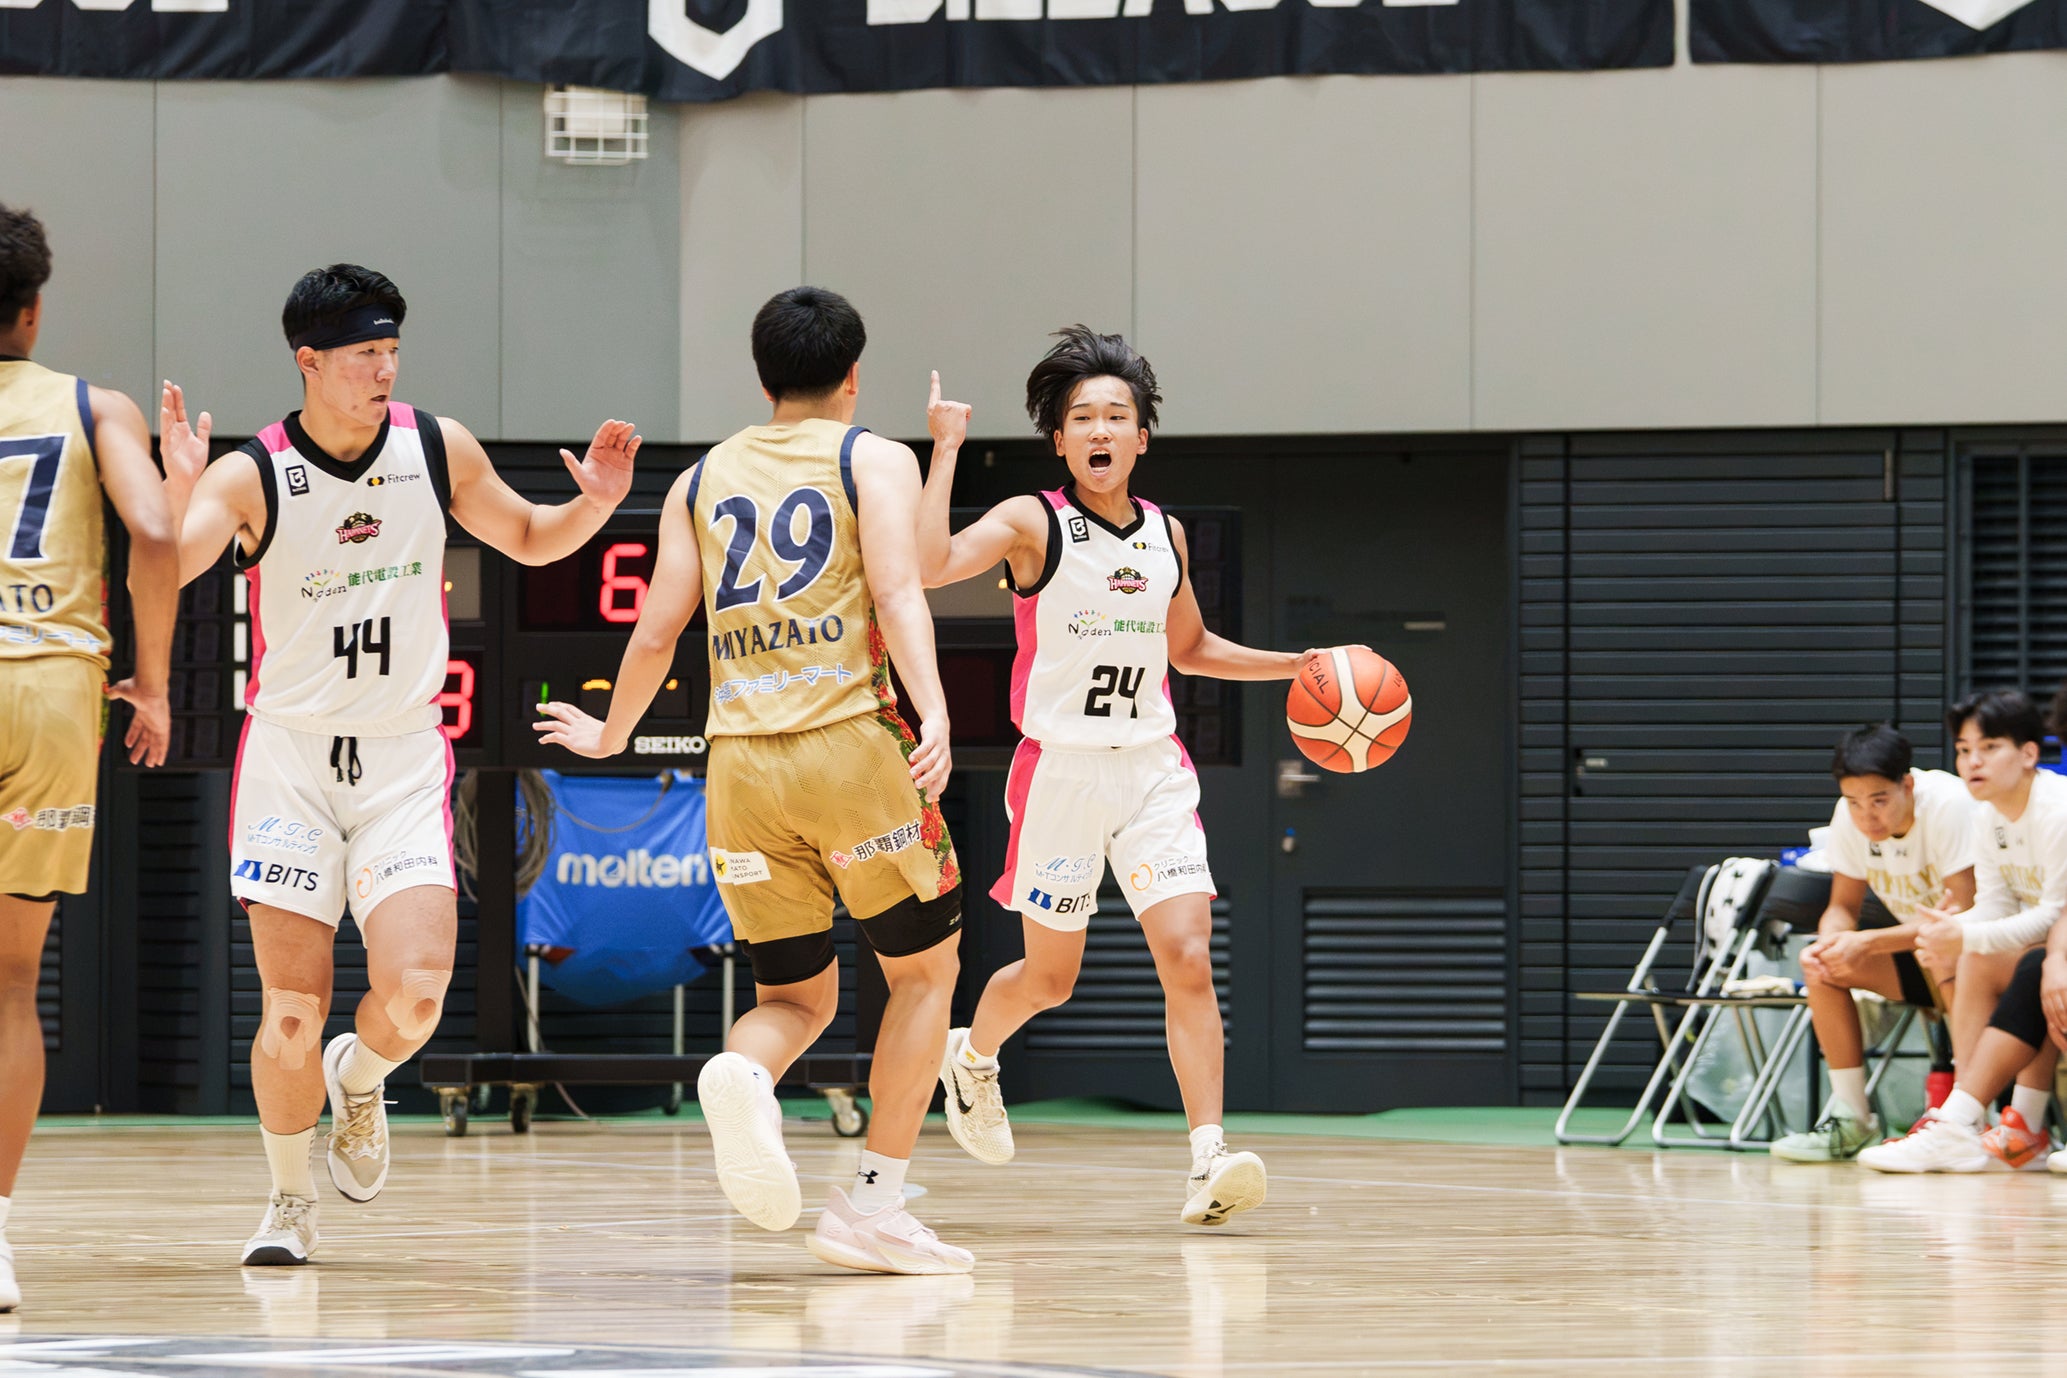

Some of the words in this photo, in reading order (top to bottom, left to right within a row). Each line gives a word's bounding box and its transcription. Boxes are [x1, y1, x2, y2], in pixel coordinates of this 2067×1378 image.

[387, 473, 421, 484] Fitcrew
[708, 485, 836, 614] 29
[347, 561, 423, 587] 能代電設工業
[600, 543, 648, 623] 6
[333, 616, 391, 679] 44
[712, 614, 844, 661] MIYAZATO
[1083, 664, 1146, 719] 24
[634, 736, 707, 754] SEIKO
[853, 820, 921, 860] 那覇鋼材
[265, 863, 319, 892] BITS
[556, 847, 708, 889] molten
